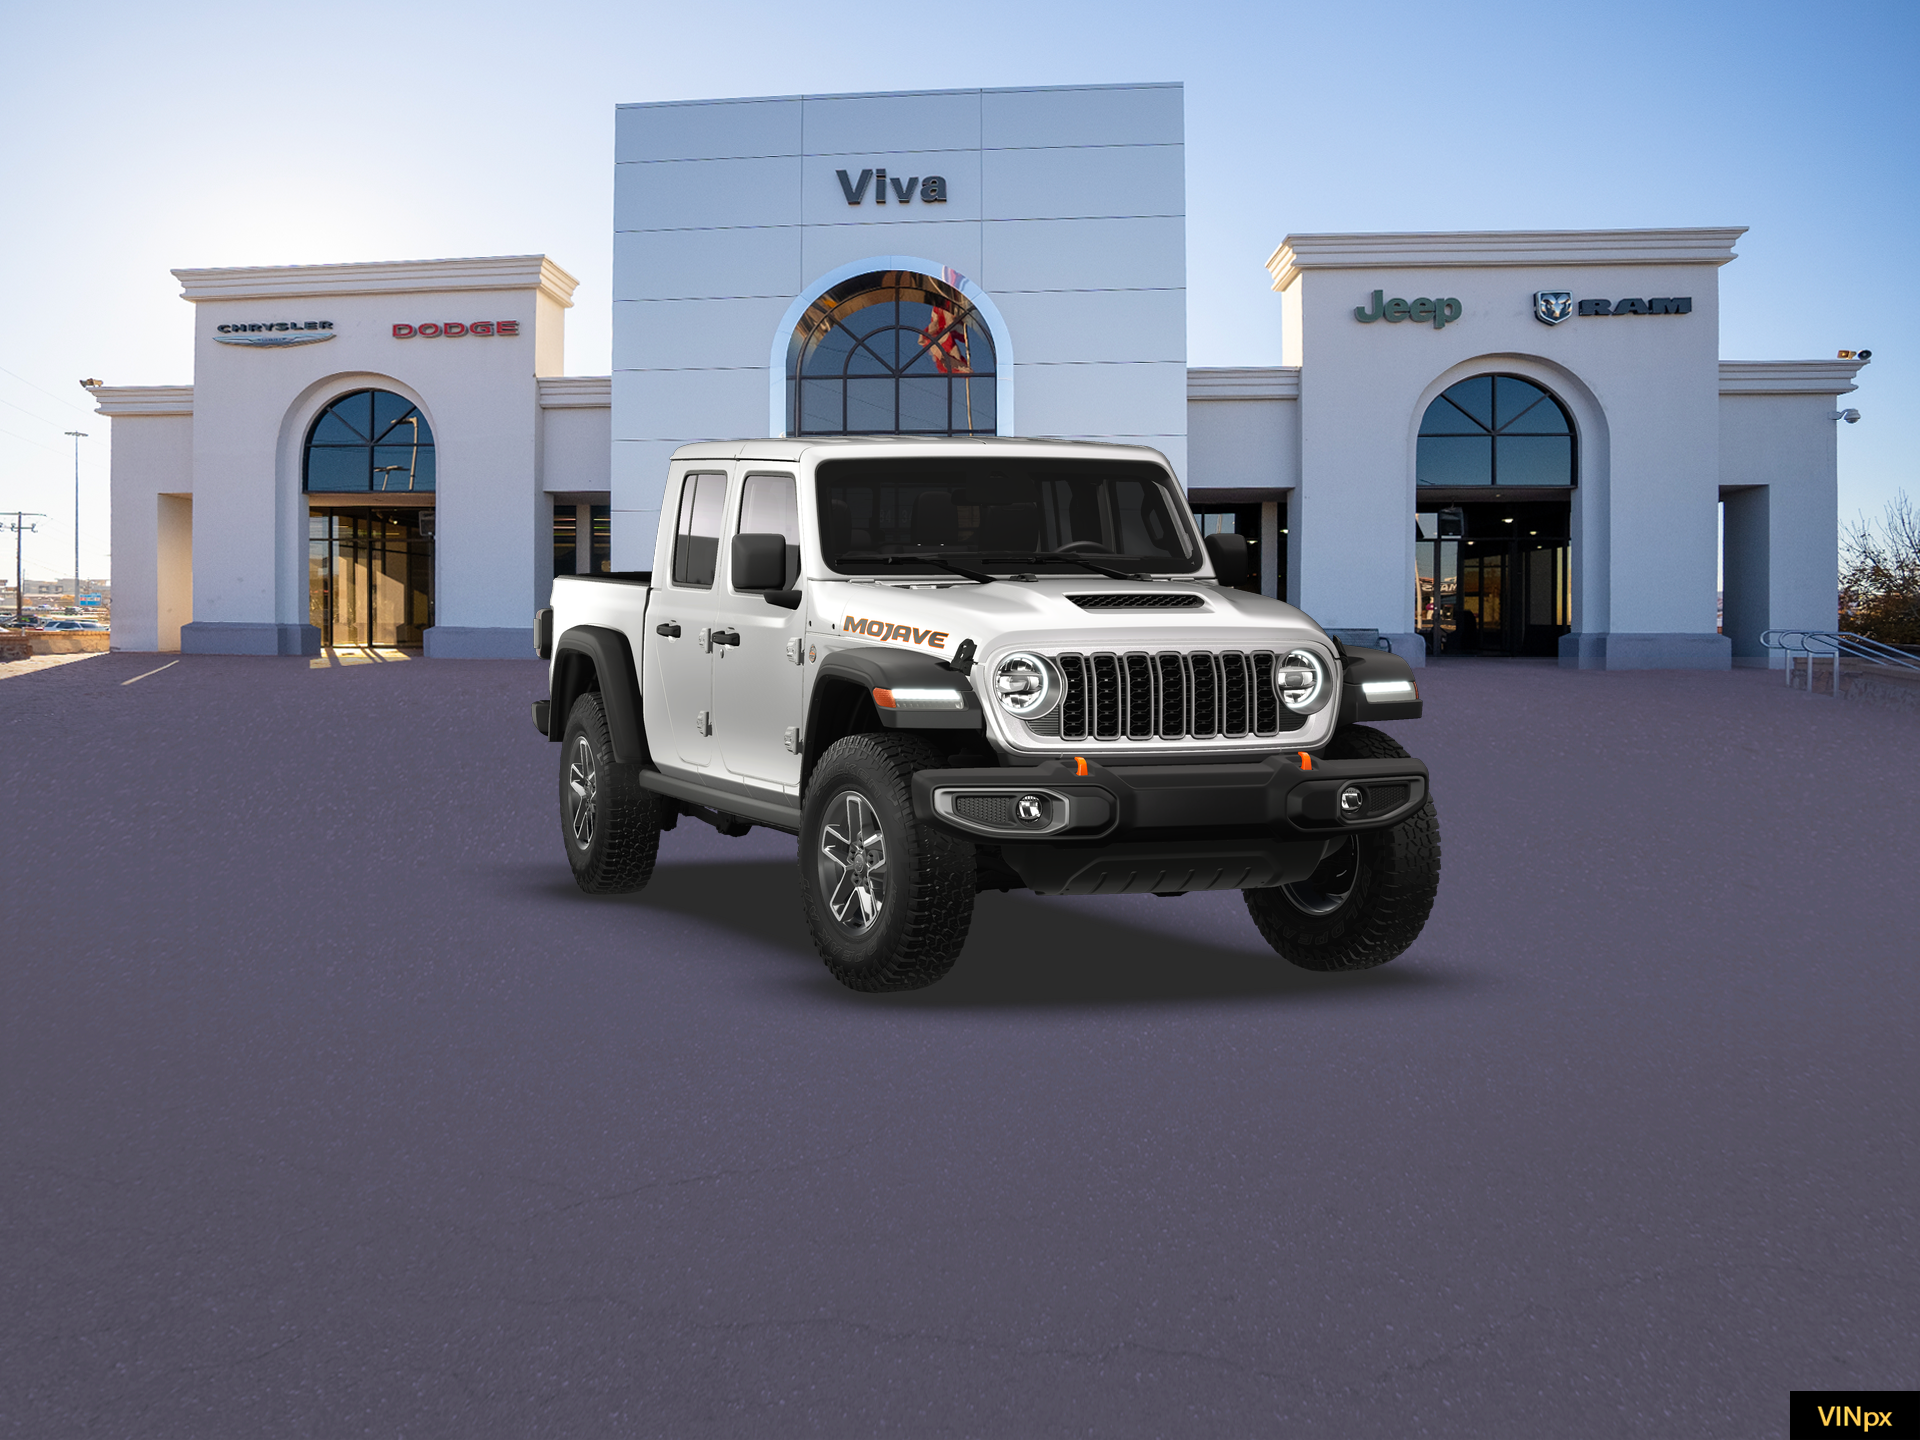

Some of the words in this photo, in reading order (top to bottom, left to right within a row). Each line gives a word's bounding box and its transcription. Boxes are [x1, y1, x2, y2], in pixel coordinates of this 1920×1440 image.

[835, 168, 947, 205] Viva
[1354, 289, 1462, 329] Jeep
[1578, 297, 1692, 316] RAM
[217, 320, 334, 334] CHRYSLER
[392, 319, 520, 339] DODGE
[843, 615, 949, 649] MOJAVE
